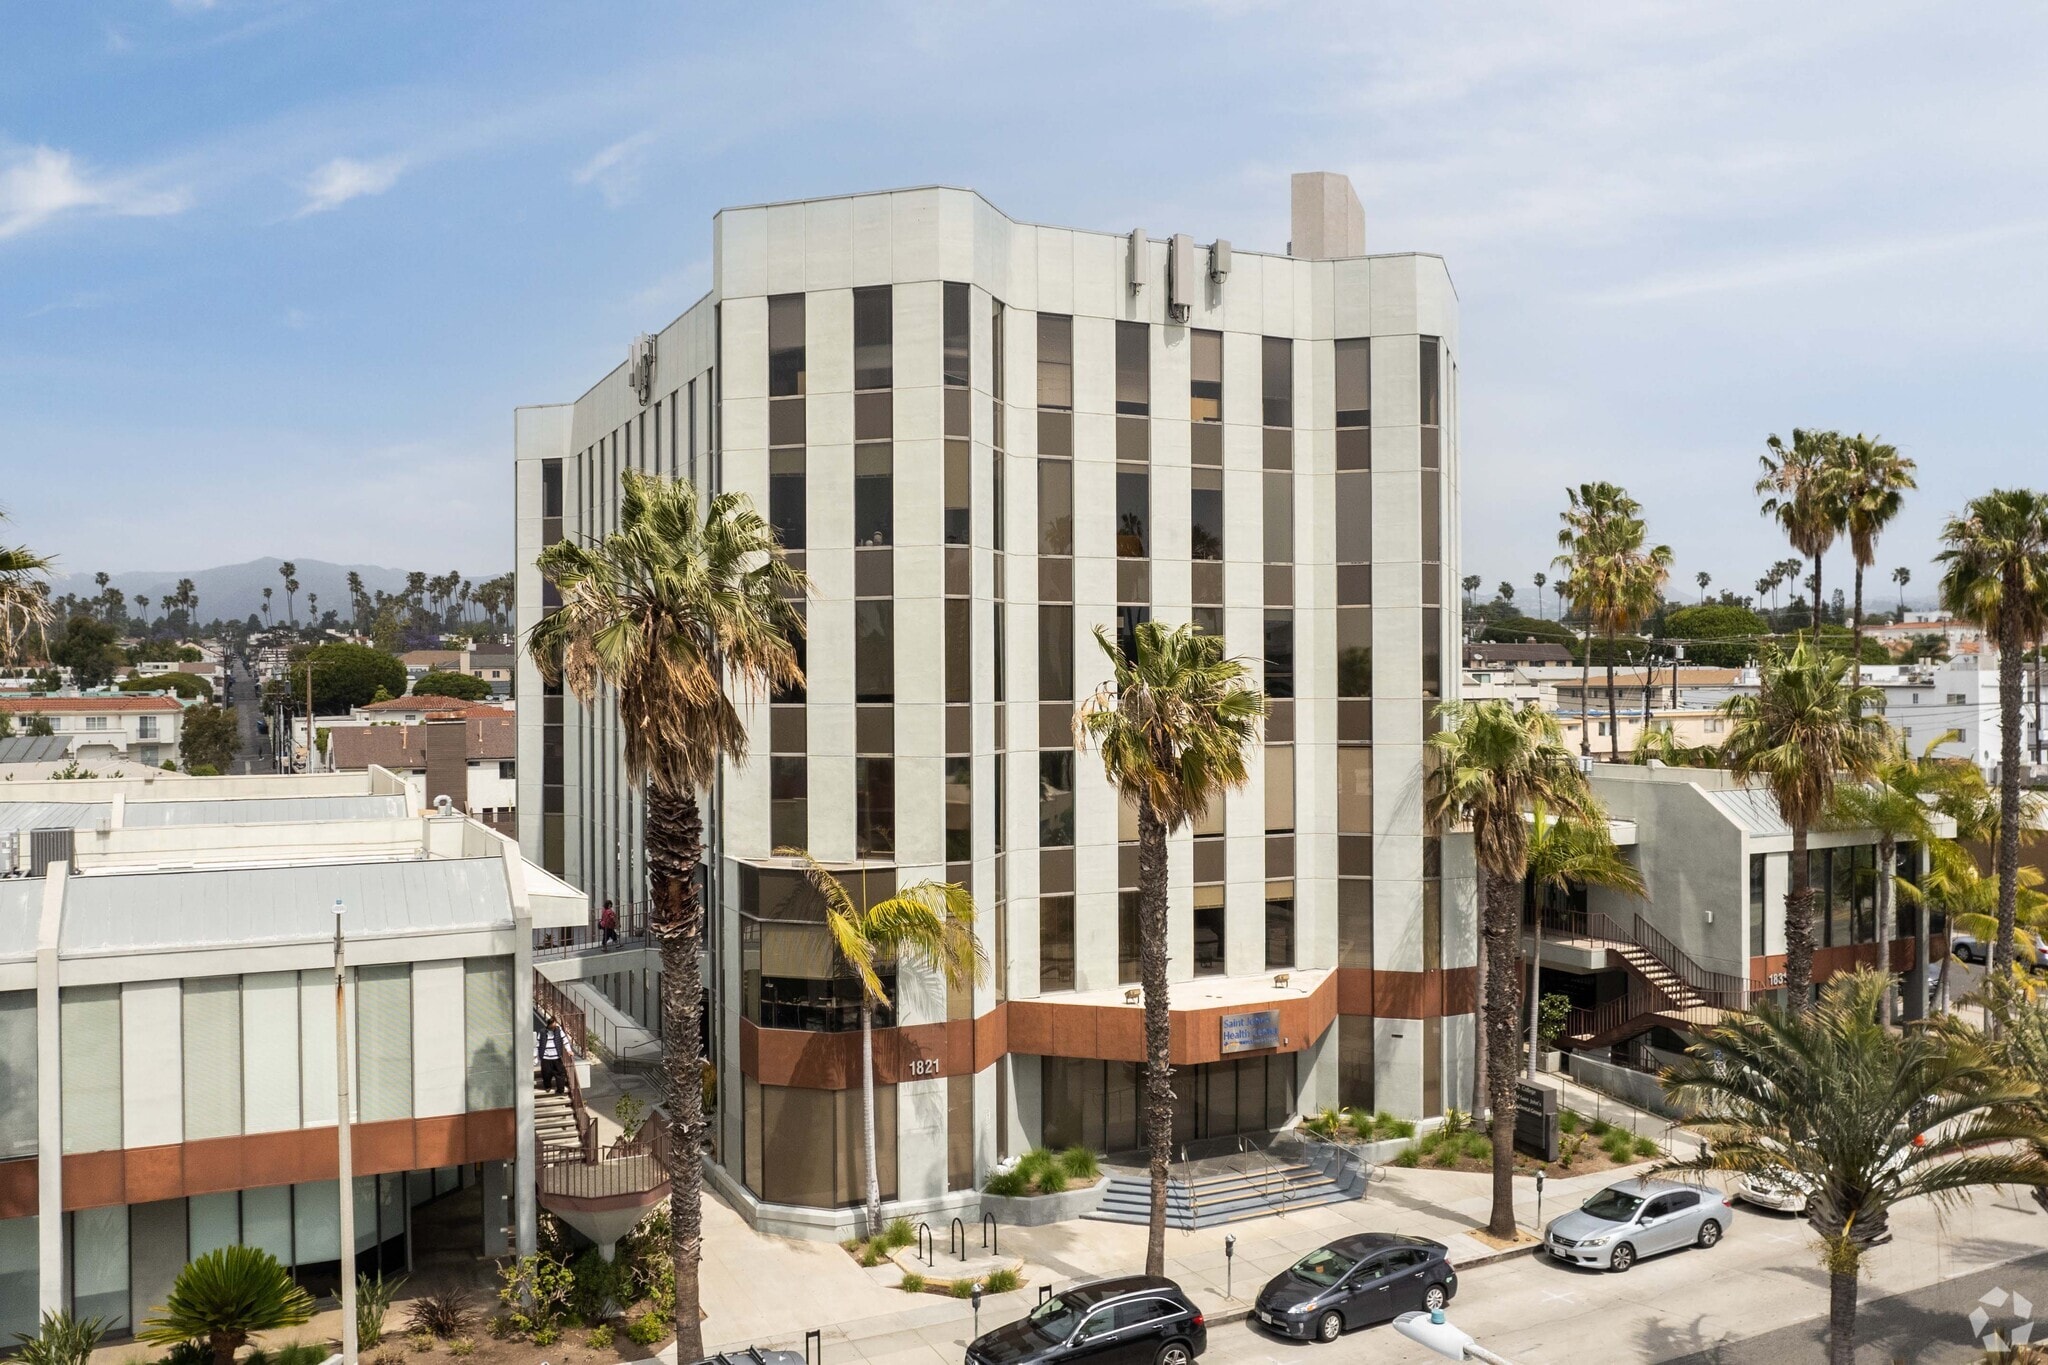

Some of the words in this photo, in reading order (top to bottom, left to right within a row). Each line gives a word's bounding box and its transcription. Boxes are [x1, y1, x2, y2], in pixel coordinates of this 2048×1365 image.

[1223, 1018, 1245, 1029] Saint
[1223, 1029, 1250, 1041] Health
[909, 1058, 939, 1076] 1821
